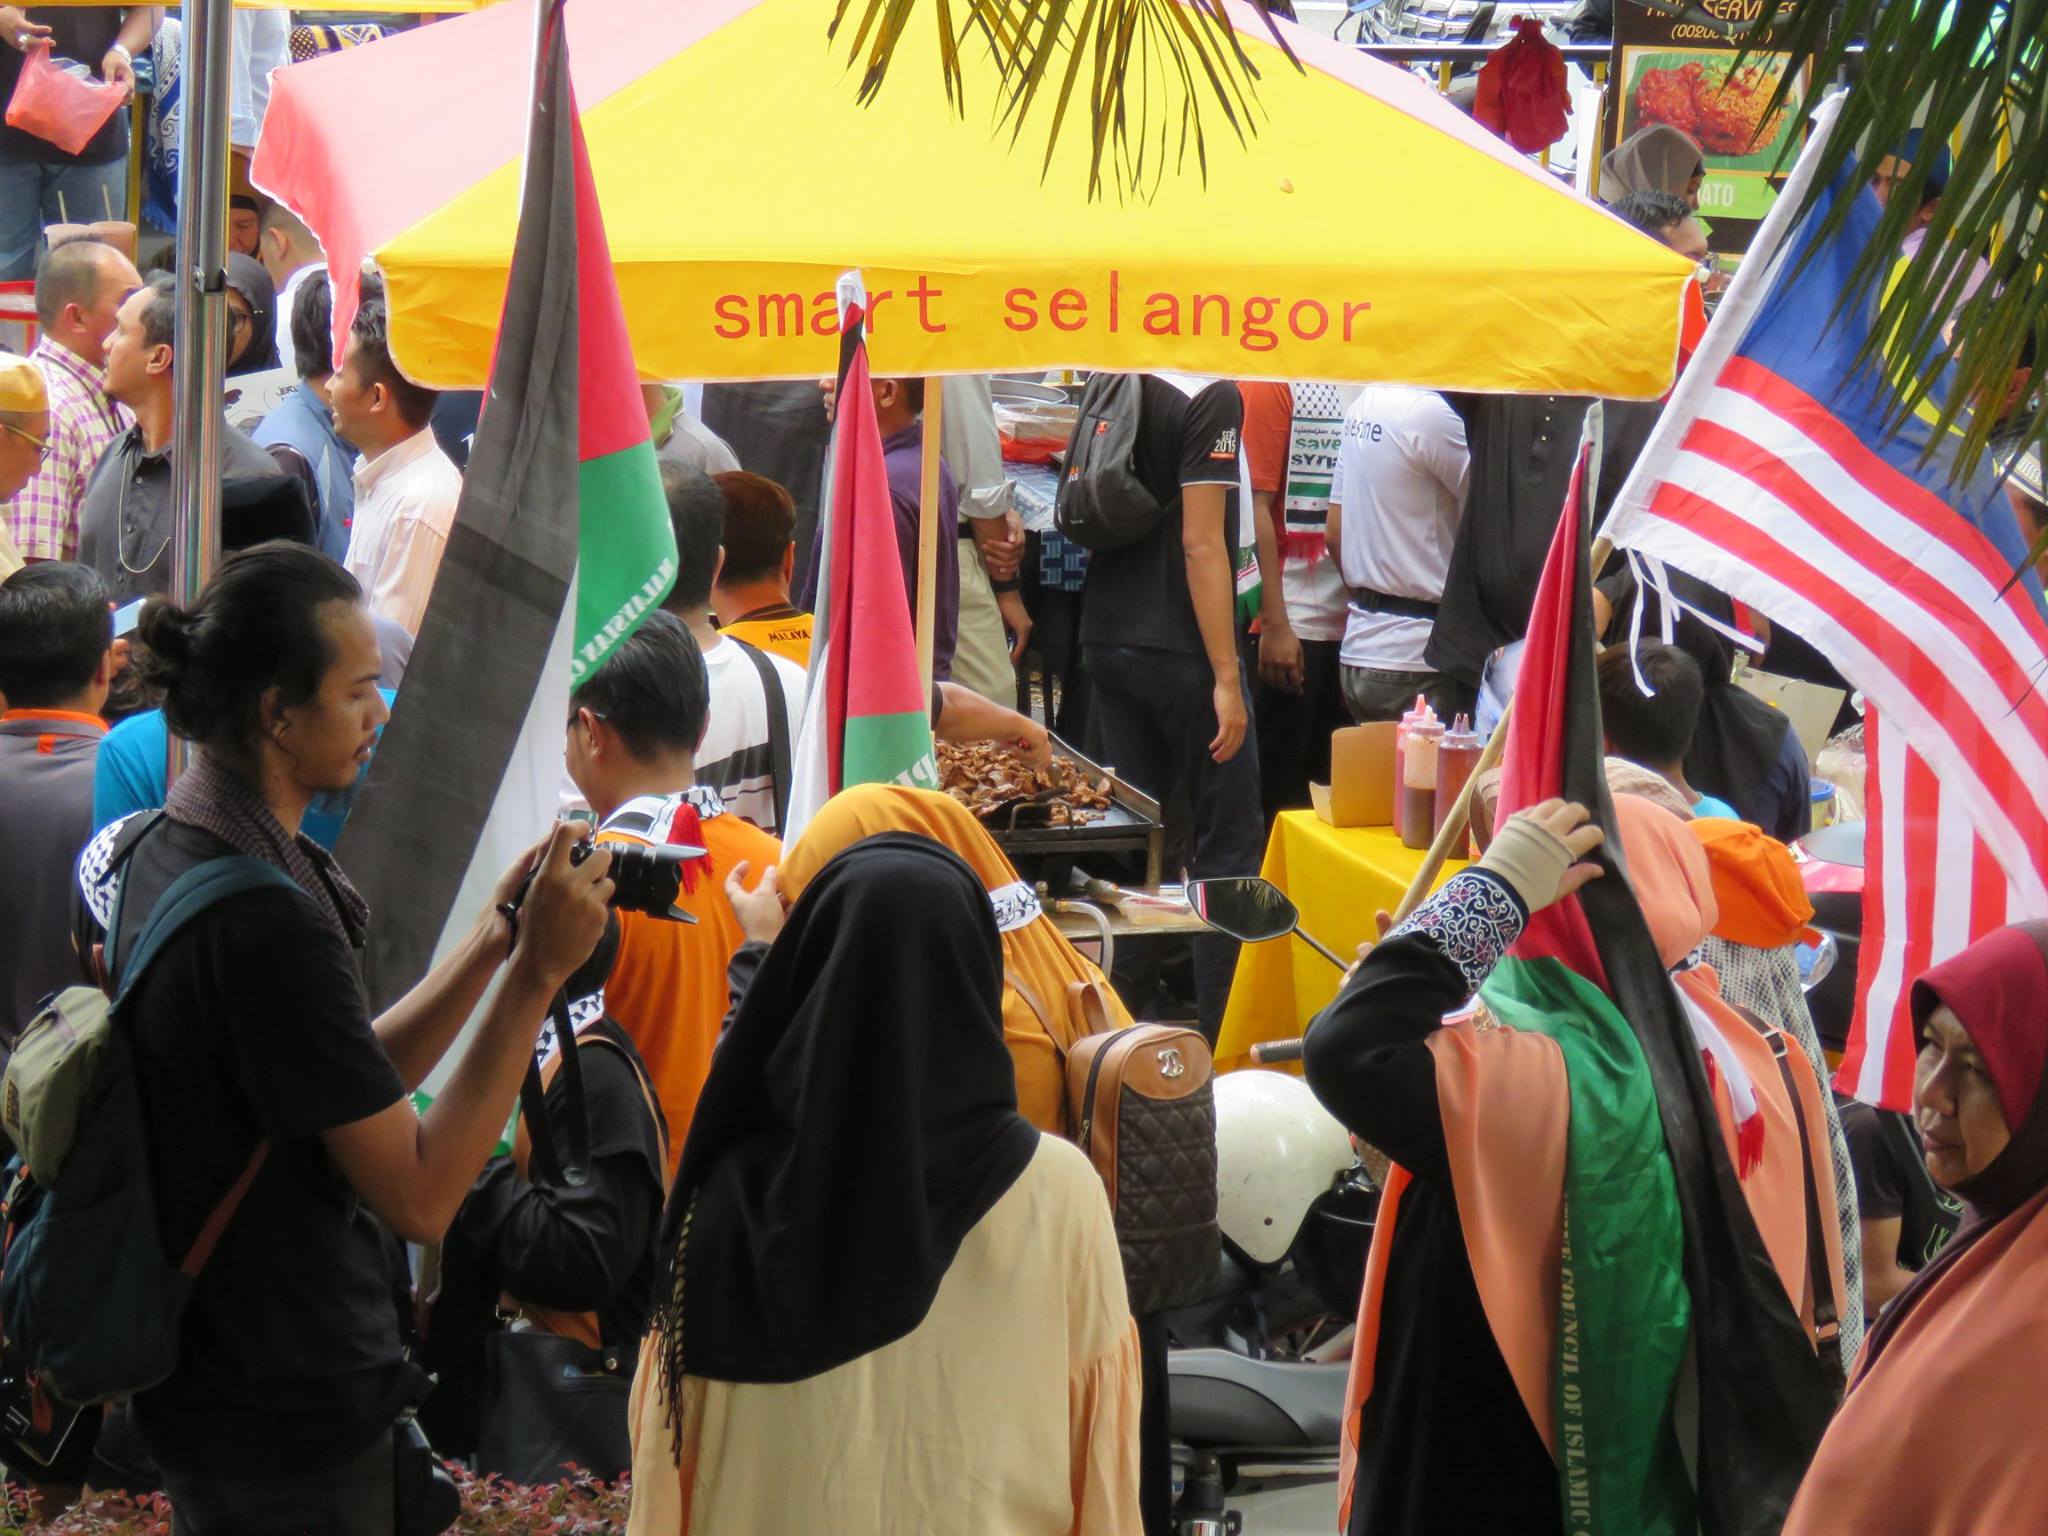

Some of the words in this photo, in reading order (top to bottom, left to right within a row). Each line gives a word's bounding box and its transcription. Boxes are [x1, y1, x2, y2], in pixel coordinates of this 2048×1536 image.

[1700, 183, 1734, 207] ATO
[714, 275, 946, 339] smart
[1003, 270, 1371, 352] selangor
[1214, 438, 1237, 453] 2015
[1294, 438, 1342, 450] save
[767, 628, 812, 643] MALAYA
[1561, 1267, 1580, 1377] COUNCIL
[1563, 1384, 1583, 1417] OF
[1564, 1422, 1592, 1525] ISLAMIC
